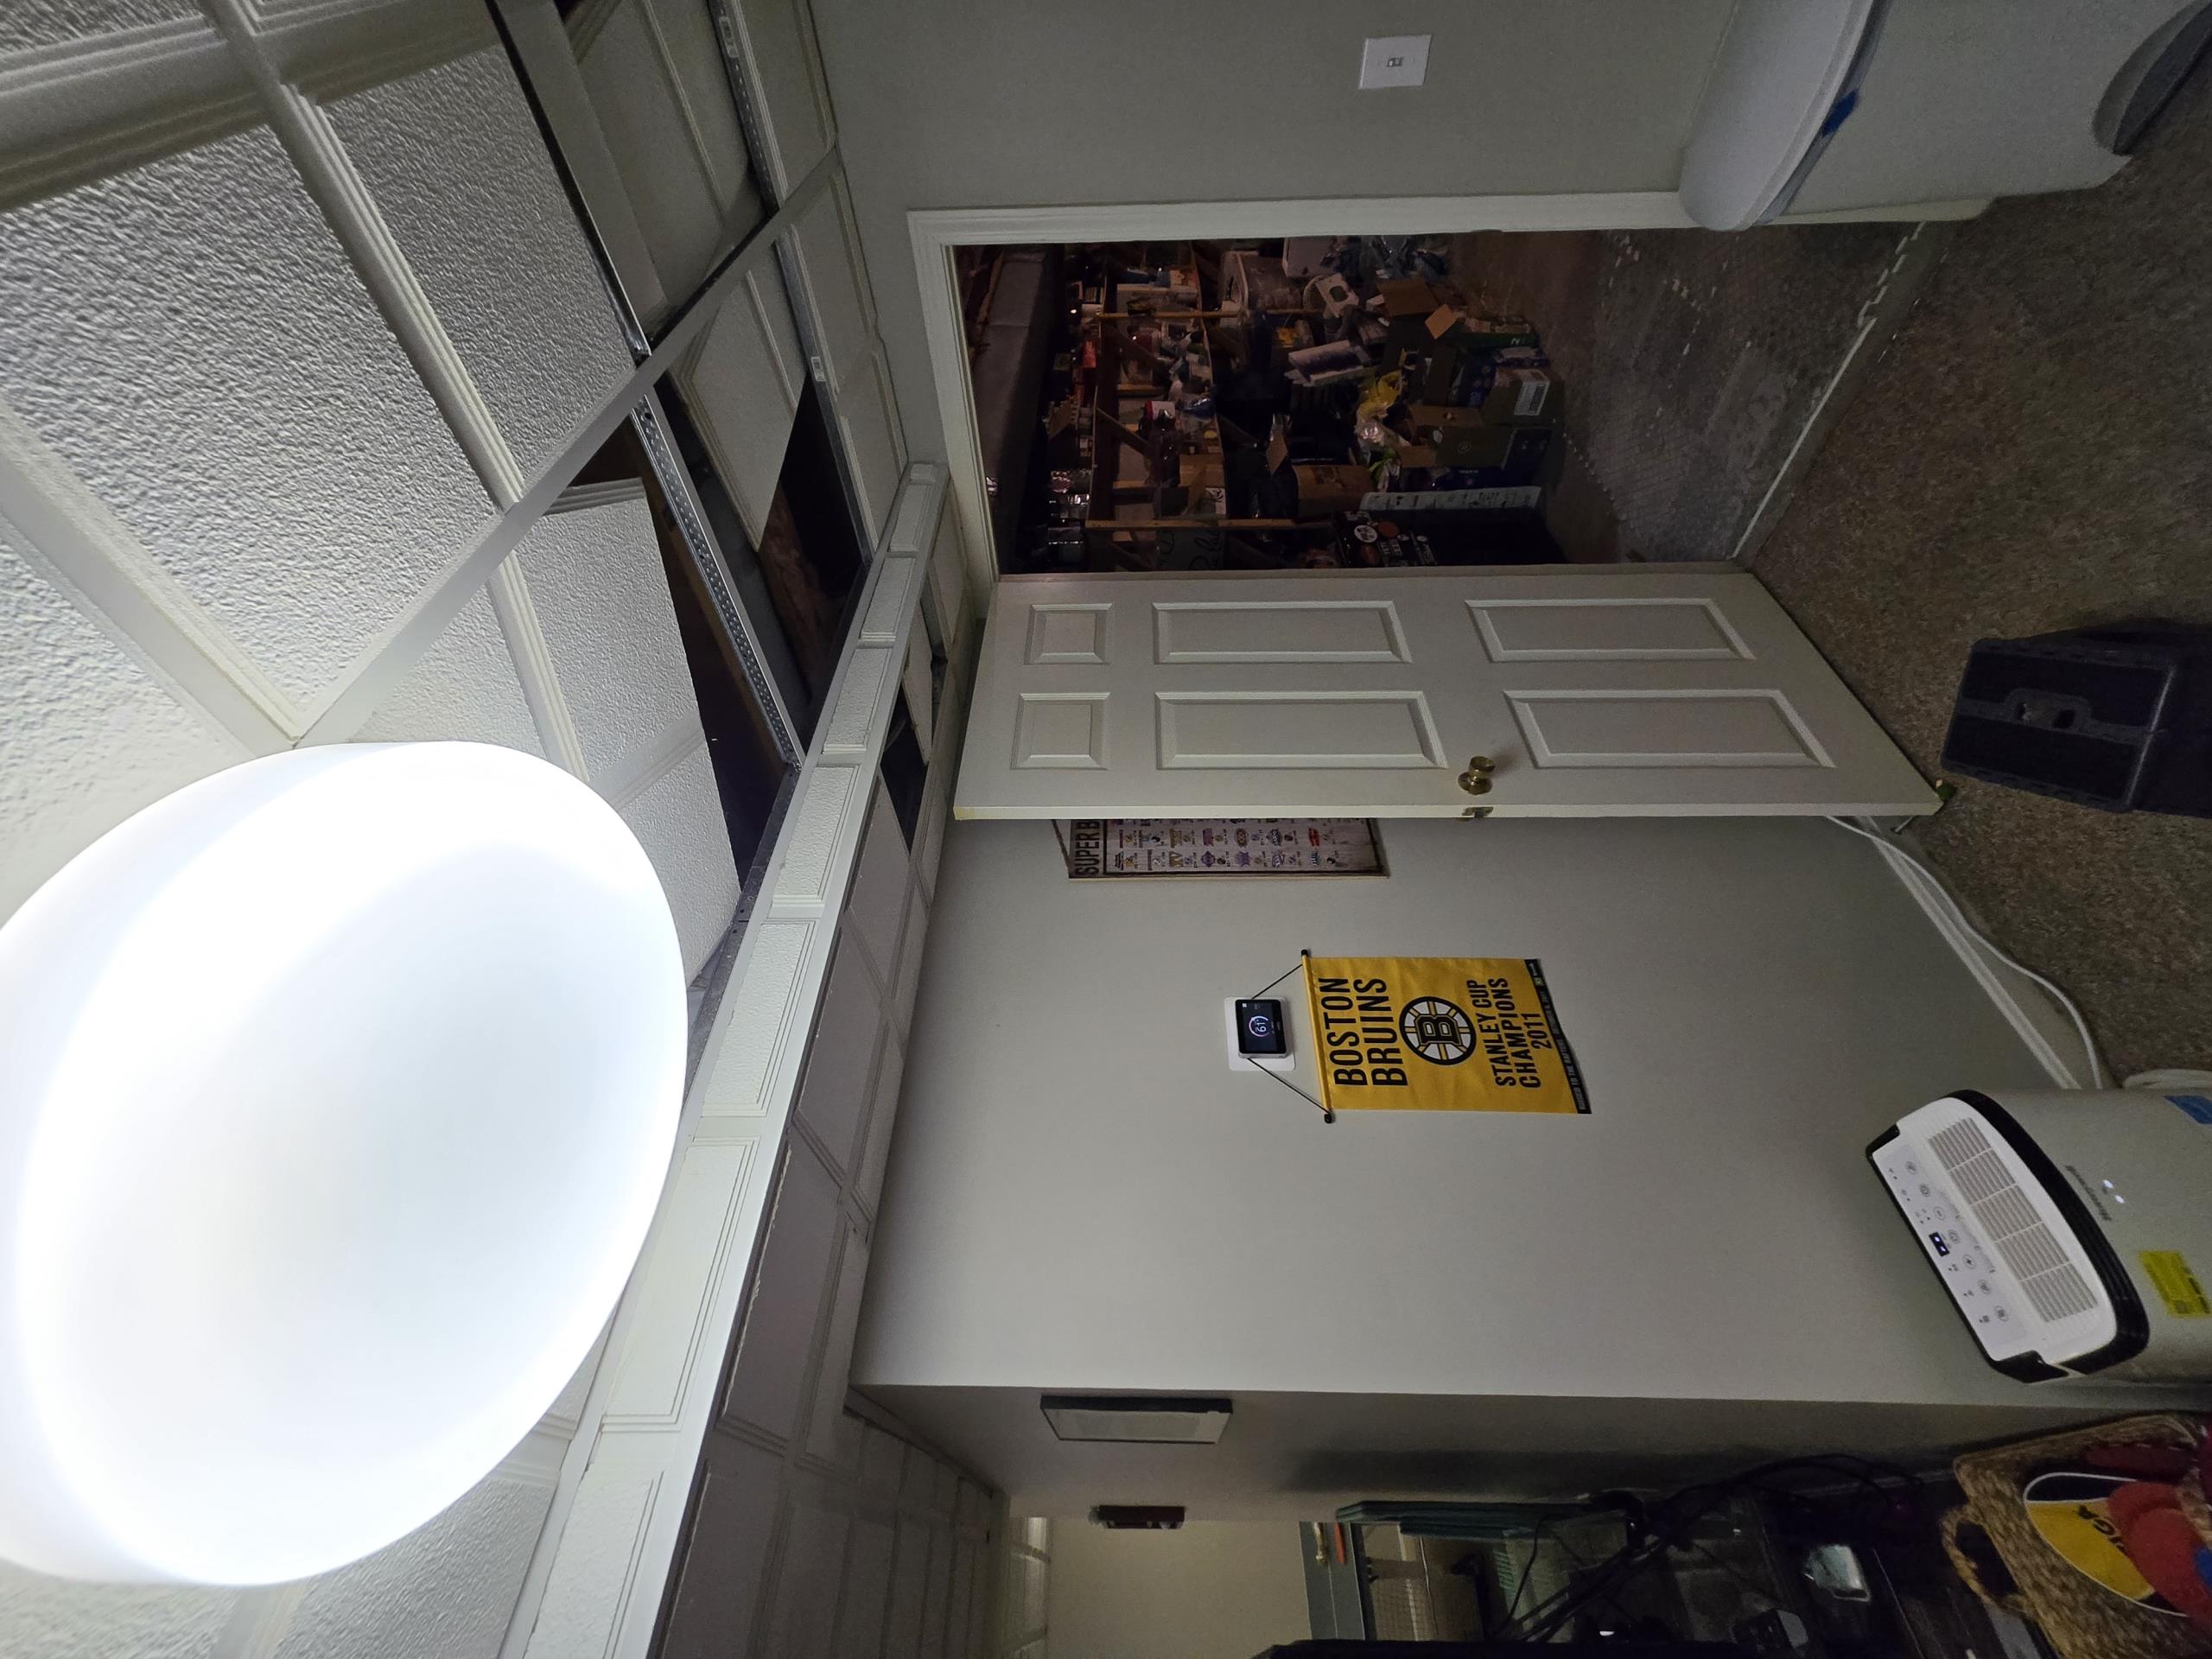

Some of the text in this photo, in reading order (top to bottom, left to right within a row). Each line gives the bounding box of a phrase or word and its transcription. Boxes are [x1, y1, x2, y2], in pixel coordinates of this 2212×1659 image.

[1075, 830, 1100, 875] SUPER
[1318, 977, 1369, 1085] BOSTON
[1353, 978, 1408, 1086] BRUINS
[1414, 1014, 1461, 1046] B
[1466, 980, 1516, 1086] STANLEY CUP
[1488, 977, 1541, 1088] CHAMPIONS
[1520, 1013, 1552, 1050] 2011
